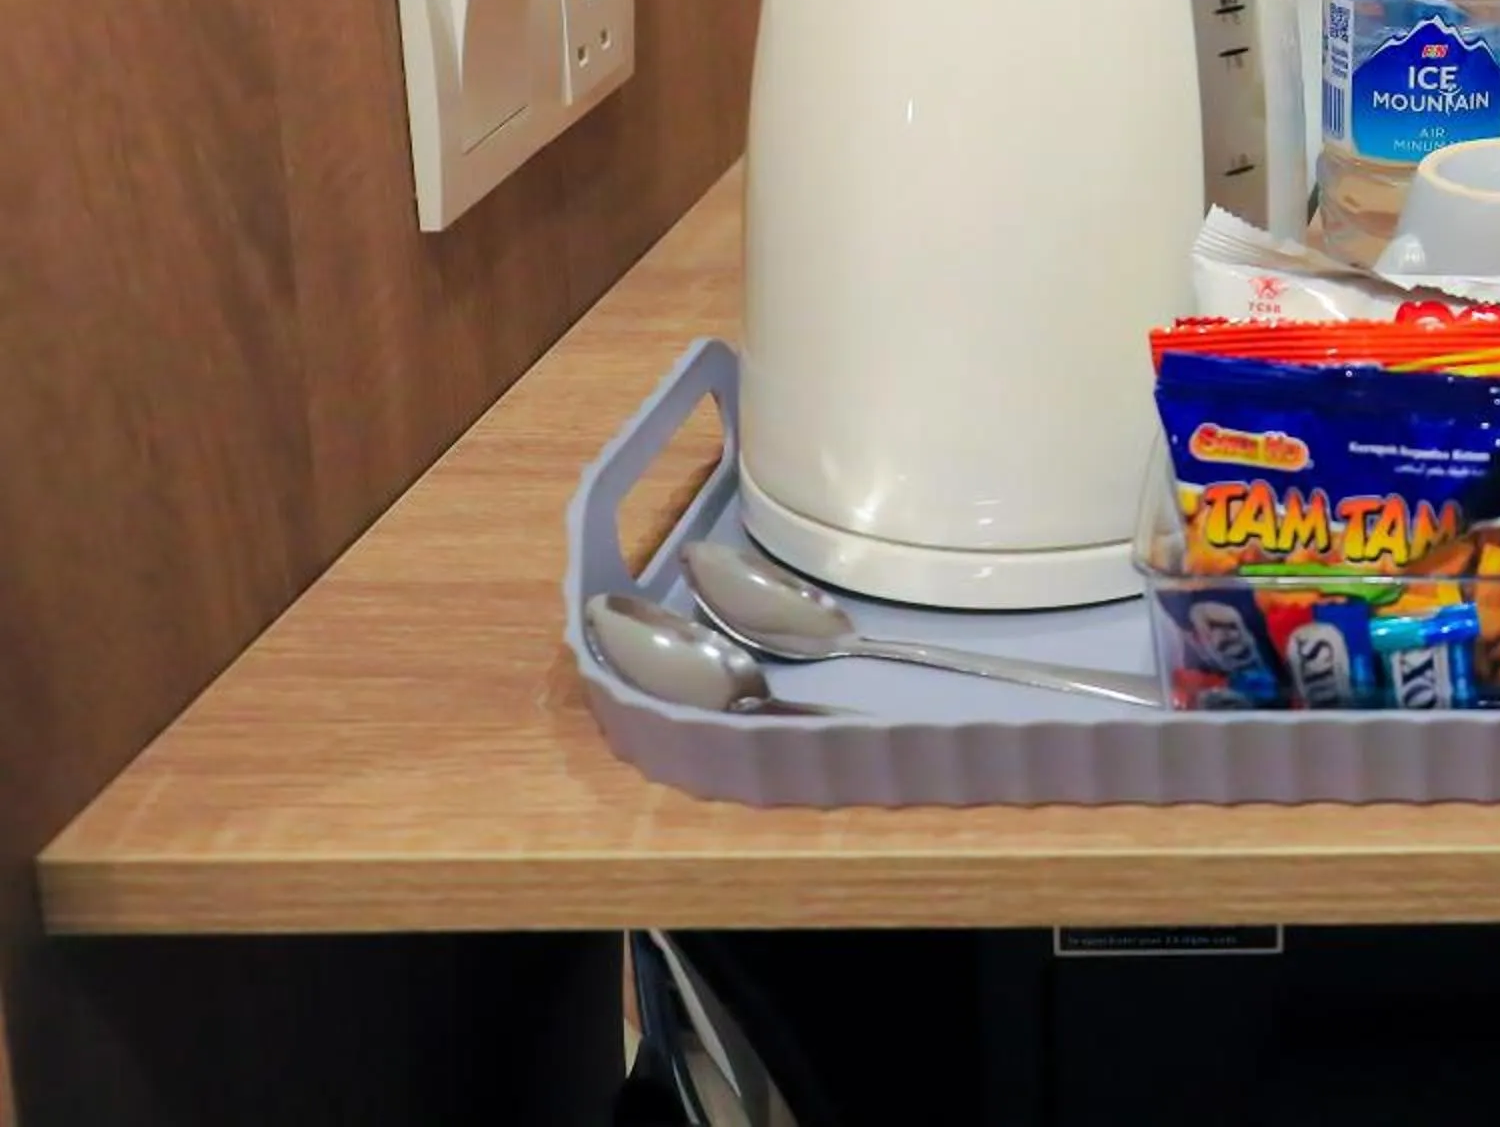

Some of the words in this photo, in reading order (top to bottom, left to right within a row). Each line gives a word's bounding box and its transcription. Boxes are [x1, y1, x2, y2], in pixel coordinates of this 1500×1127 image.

[1408, 66, 1457, 91] ICE
[1372, 89, 1490, 114] MOUNTAIN
[1393, 139, 1455, 152] MINUM
[1419, 128, 1446, 139] AIR
[1203, 479, 1331, 553] TAM
[1336, 494, 1464, 565] TAM
